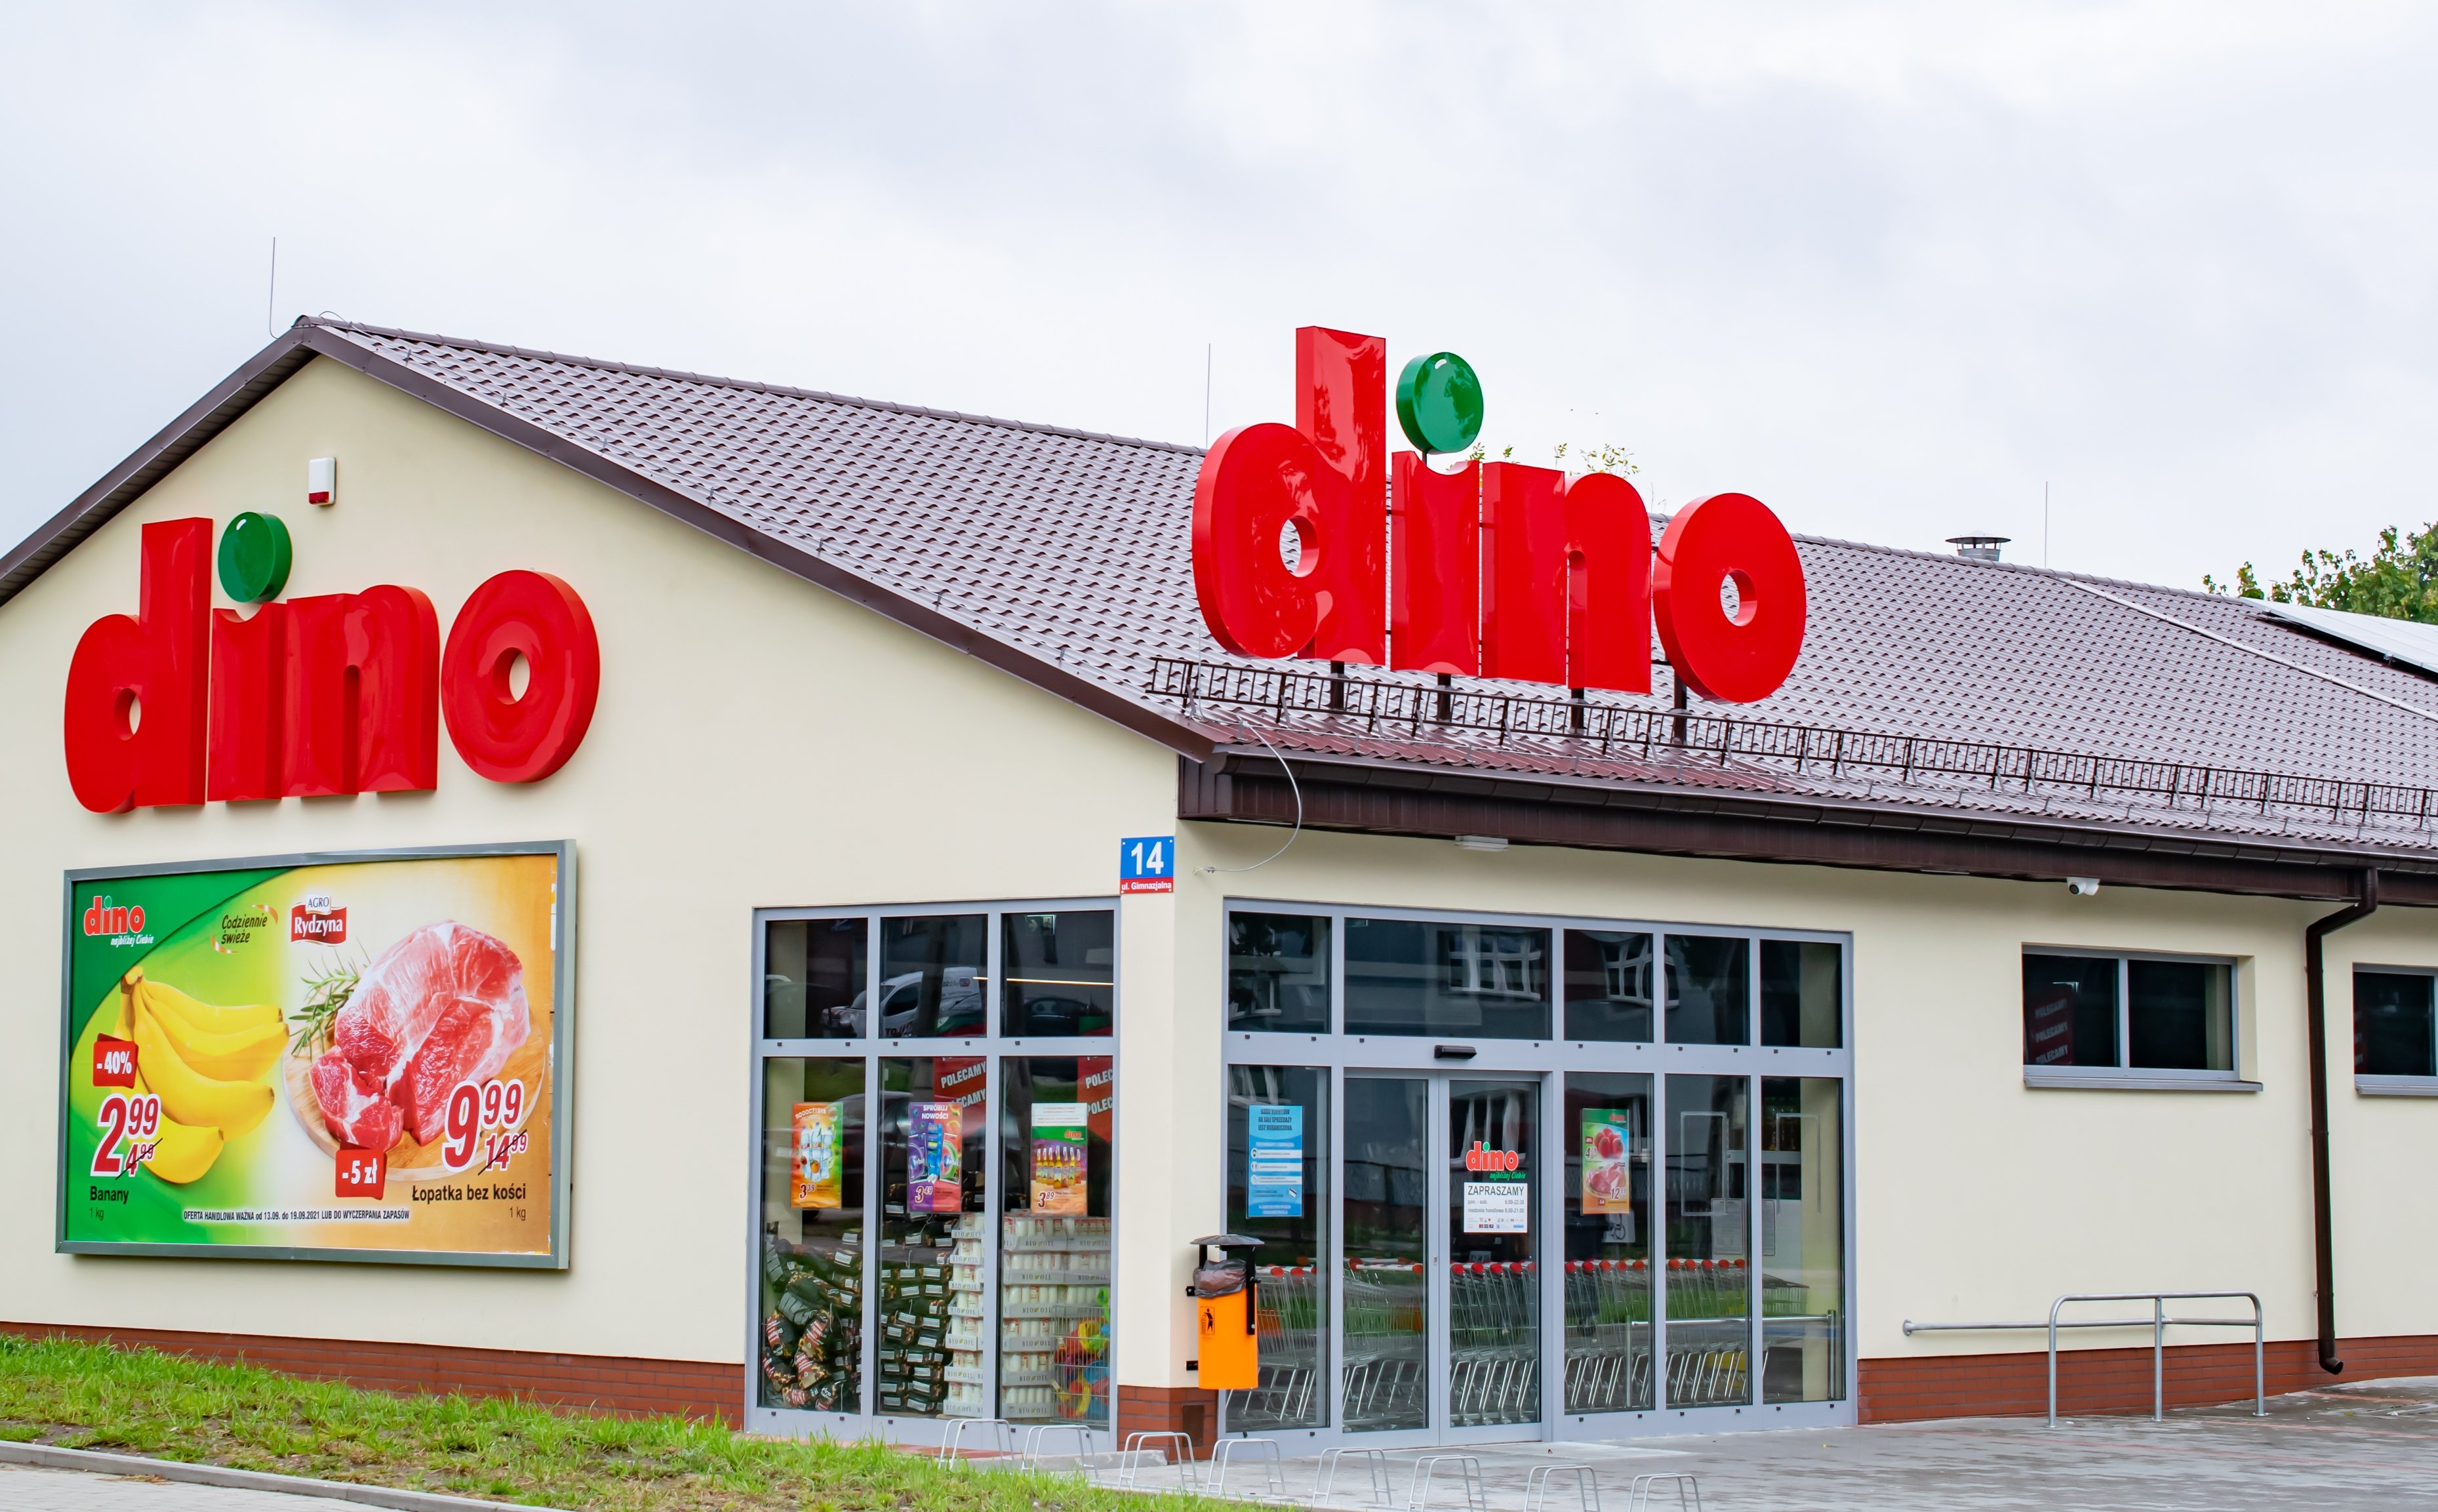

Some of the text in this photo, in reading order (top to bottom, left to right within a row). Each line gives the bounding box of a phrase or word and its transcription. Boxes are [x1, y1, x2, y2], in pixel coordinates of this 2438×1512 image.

[1191, 326, 1807, 703] dino
[64, 511, 600, 814] dino
[1131, 841, 1164, 875] 14
[1131, 881, 1172, 890] Gimnazjalna
[308, 897, 329, 907] AGRO
[83, 895, 146, 936] dino
[222, 913, 268, 929] Codziennie
[294, 914, 343, 938] Rydzyna
[110, 934, 154, 947] najbliżej Ciebie
[221, 929, 250, 944] świeże
[941, 1061, 986, 1088] POLECAMY
[1085, 1069, 1113, 1089] POLEC
[1466, 1141, 1519, 1171] dino
[364, 1158, 377, 1184] zł
[90, 1186, 129, 1204] Banany
[412, 1184, 526, 1204] Łopatka bez kości
[1468, 1185, 1524, 1195] ZAPRASZAMY
[96, 1207, 104, 1221] kg
[184, 1211, 203, 1220] OFERTA
[236, 1210, 254, 1220] WAŻNA
[290, 1211, 319, 1220] 19.09.2021
[322, 1210, 332, 1219] LUB
[334, 1210, 341, 1219] DO
[383, 1208, 409, 1219] ZAPASÓW
[517, 1206, 526, 1221] kg
